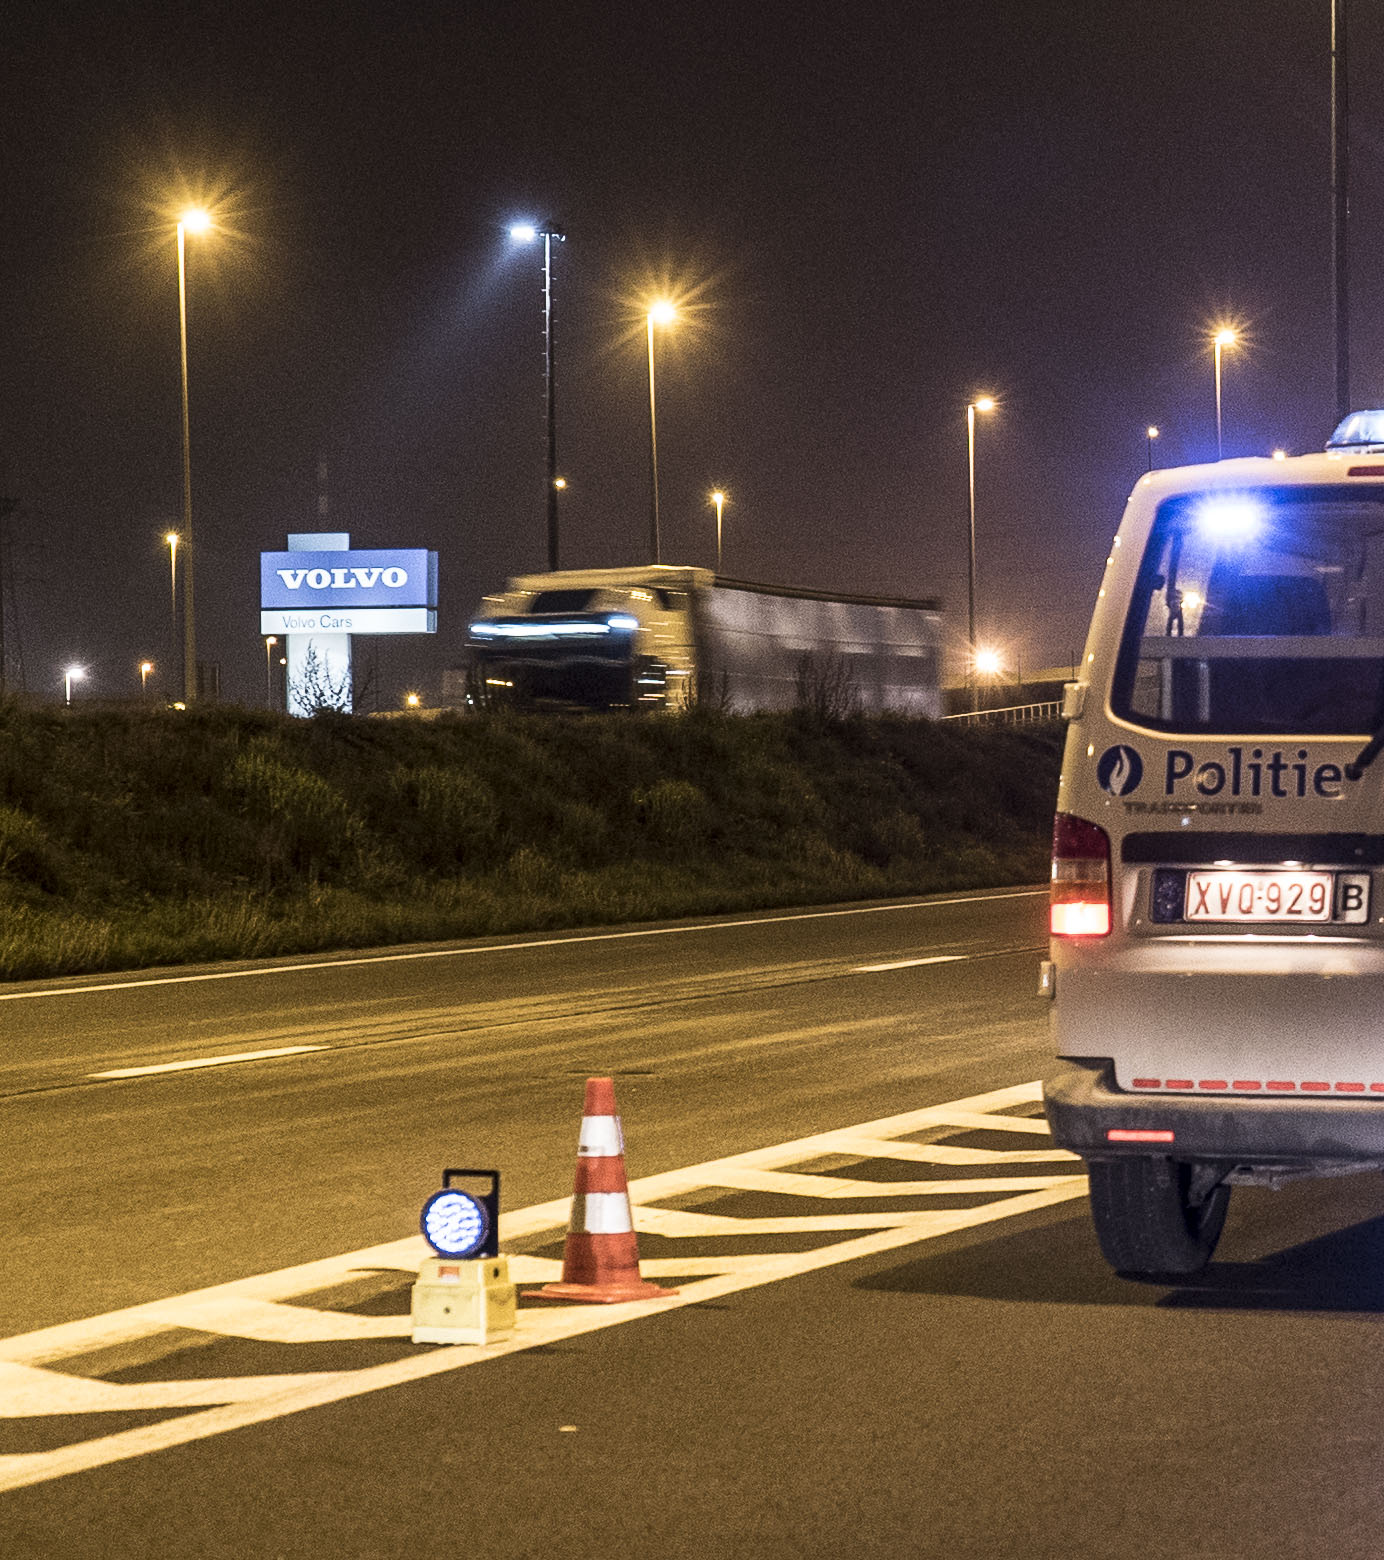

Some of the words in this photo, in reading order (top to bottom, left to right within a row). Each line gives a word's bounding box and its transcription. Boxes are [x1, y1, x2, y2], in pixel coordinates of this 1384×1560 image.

[276, 567, 408, 589] VOLVO
[282, 616, 316, 629] Volvo
[319, 614, 353, 629] Cars
[1165, 747, 1342, 798] Politie
[1342, 883, 1364, 912] B
